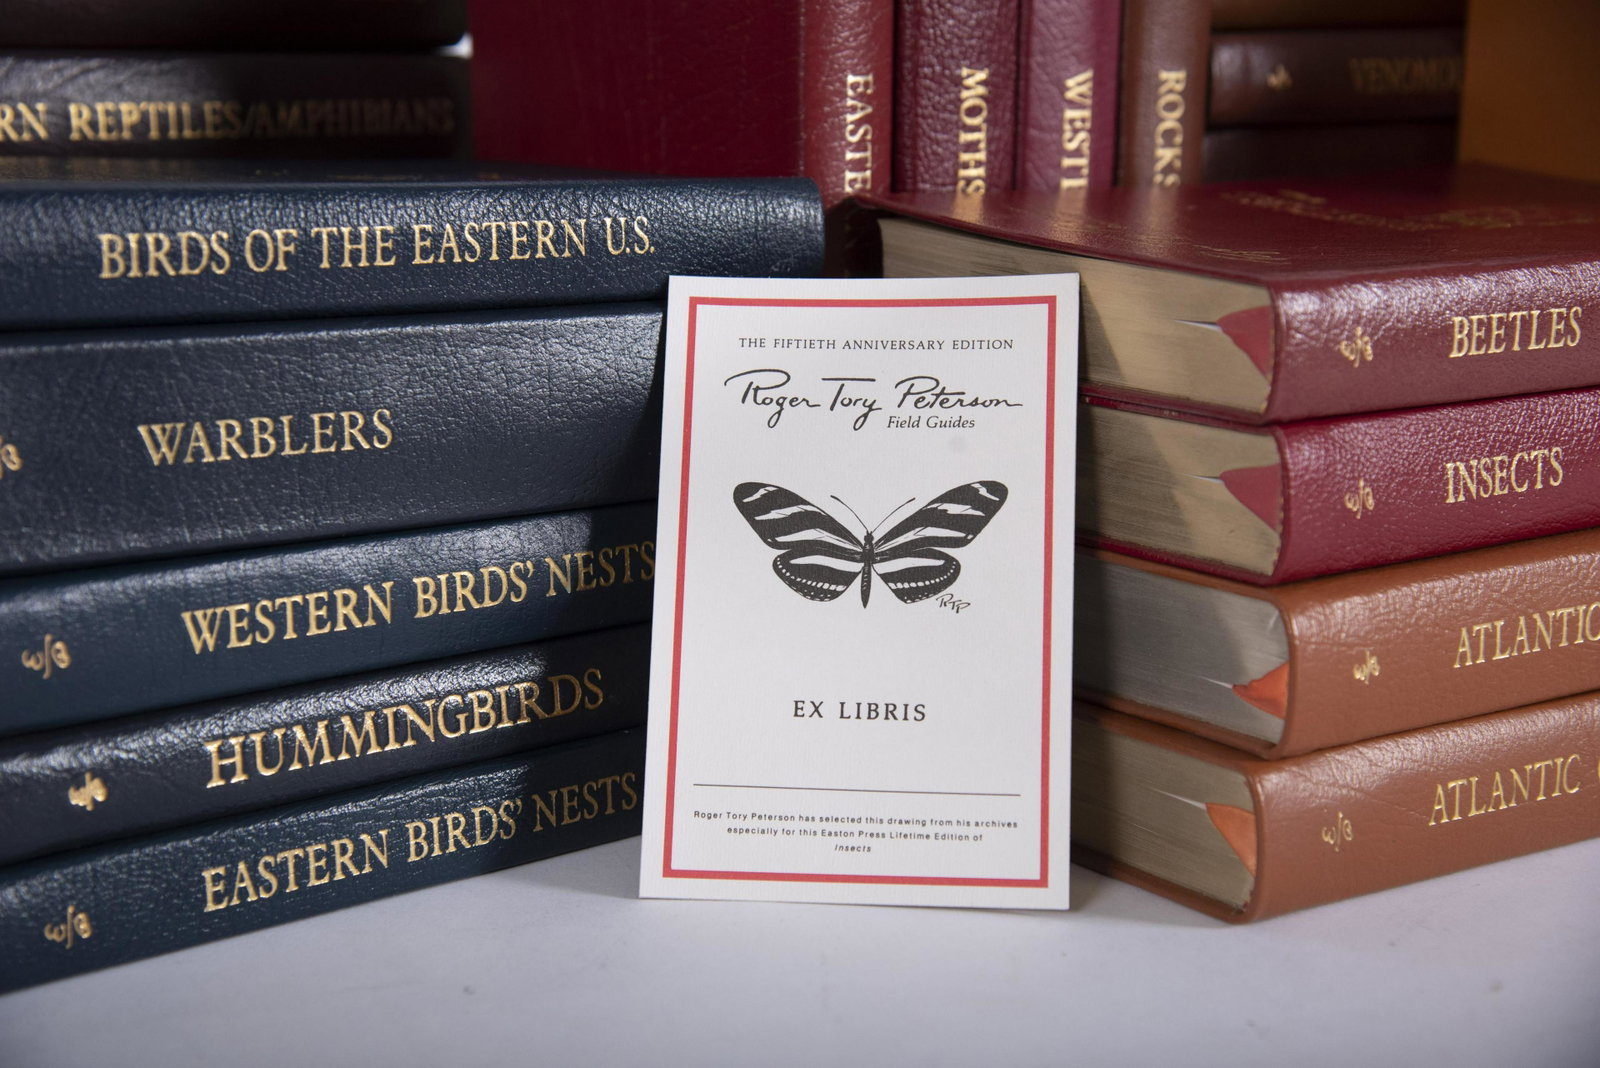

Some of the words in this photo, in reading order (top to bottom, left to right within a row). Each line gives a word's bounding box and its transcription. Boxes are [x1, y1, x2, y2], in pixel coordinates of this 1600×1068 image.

[957, 67, 990, 197] MOTHS
[1153, 70, 1187, 187] ROCKS
[101, 231, 231, 279] BIRDS
[245, 228, 298, 272] OF
[312, 226, 396, 269] THE
[411, 218, 589, 265] EASTERN
[605, 215, 656, 257] U.S.
[739, 338, 766, 349] THE
[773, 339, 836, 350] FIFTIETH
[842, 339, 945, 350] ANNIVERSARY
[952, 339, 1014, 350] EDITION
[1450, 306, 1583, 359] BEETLES
[724, 368, 821, 429] Roger
[821, 377, 883, 431] Tory
[895, 375, 1023, 410] Peterson
[887, 415, 921, 429] Field
[926, 416, 975, 429] Guides
[138, 408, 394, 467] WARBLERS
[1445, 446, 1564, 504] INSECTS
[181, 581, 395, 656] WESTERN
[545, 541, 655, 598] NESTS
[1454, 602, 1600, 668] ATLANTIC
[204, 667, 605, 790] HUMMINGBIRDS
[793, 700, 824, 718] EX
[839, 701, 926, 721] LIBRIS
[693, 811, 722, 820] Roger
[726, 812, 748, 821] Tory
[751, 813, 795, 821] Peterson
[865, 817, 884, 825] this
[887, 818, 927, 827] drawing
[930, 819, 953, 827] from
[956, 819, 971, 827] his
[974, 820, 1018, 828] archives
[1429, 754, 1581, 827] ATLANTIC
[201, 829, 390, 914] EASTERN
[533, 772, 638, 831] NESTS
[727, 827, 778, 836] especially
[889, 832, 931, 840] Lifetime
[934, 833, 970, 841] Edition
[834, 844, 872, 852] Insects
